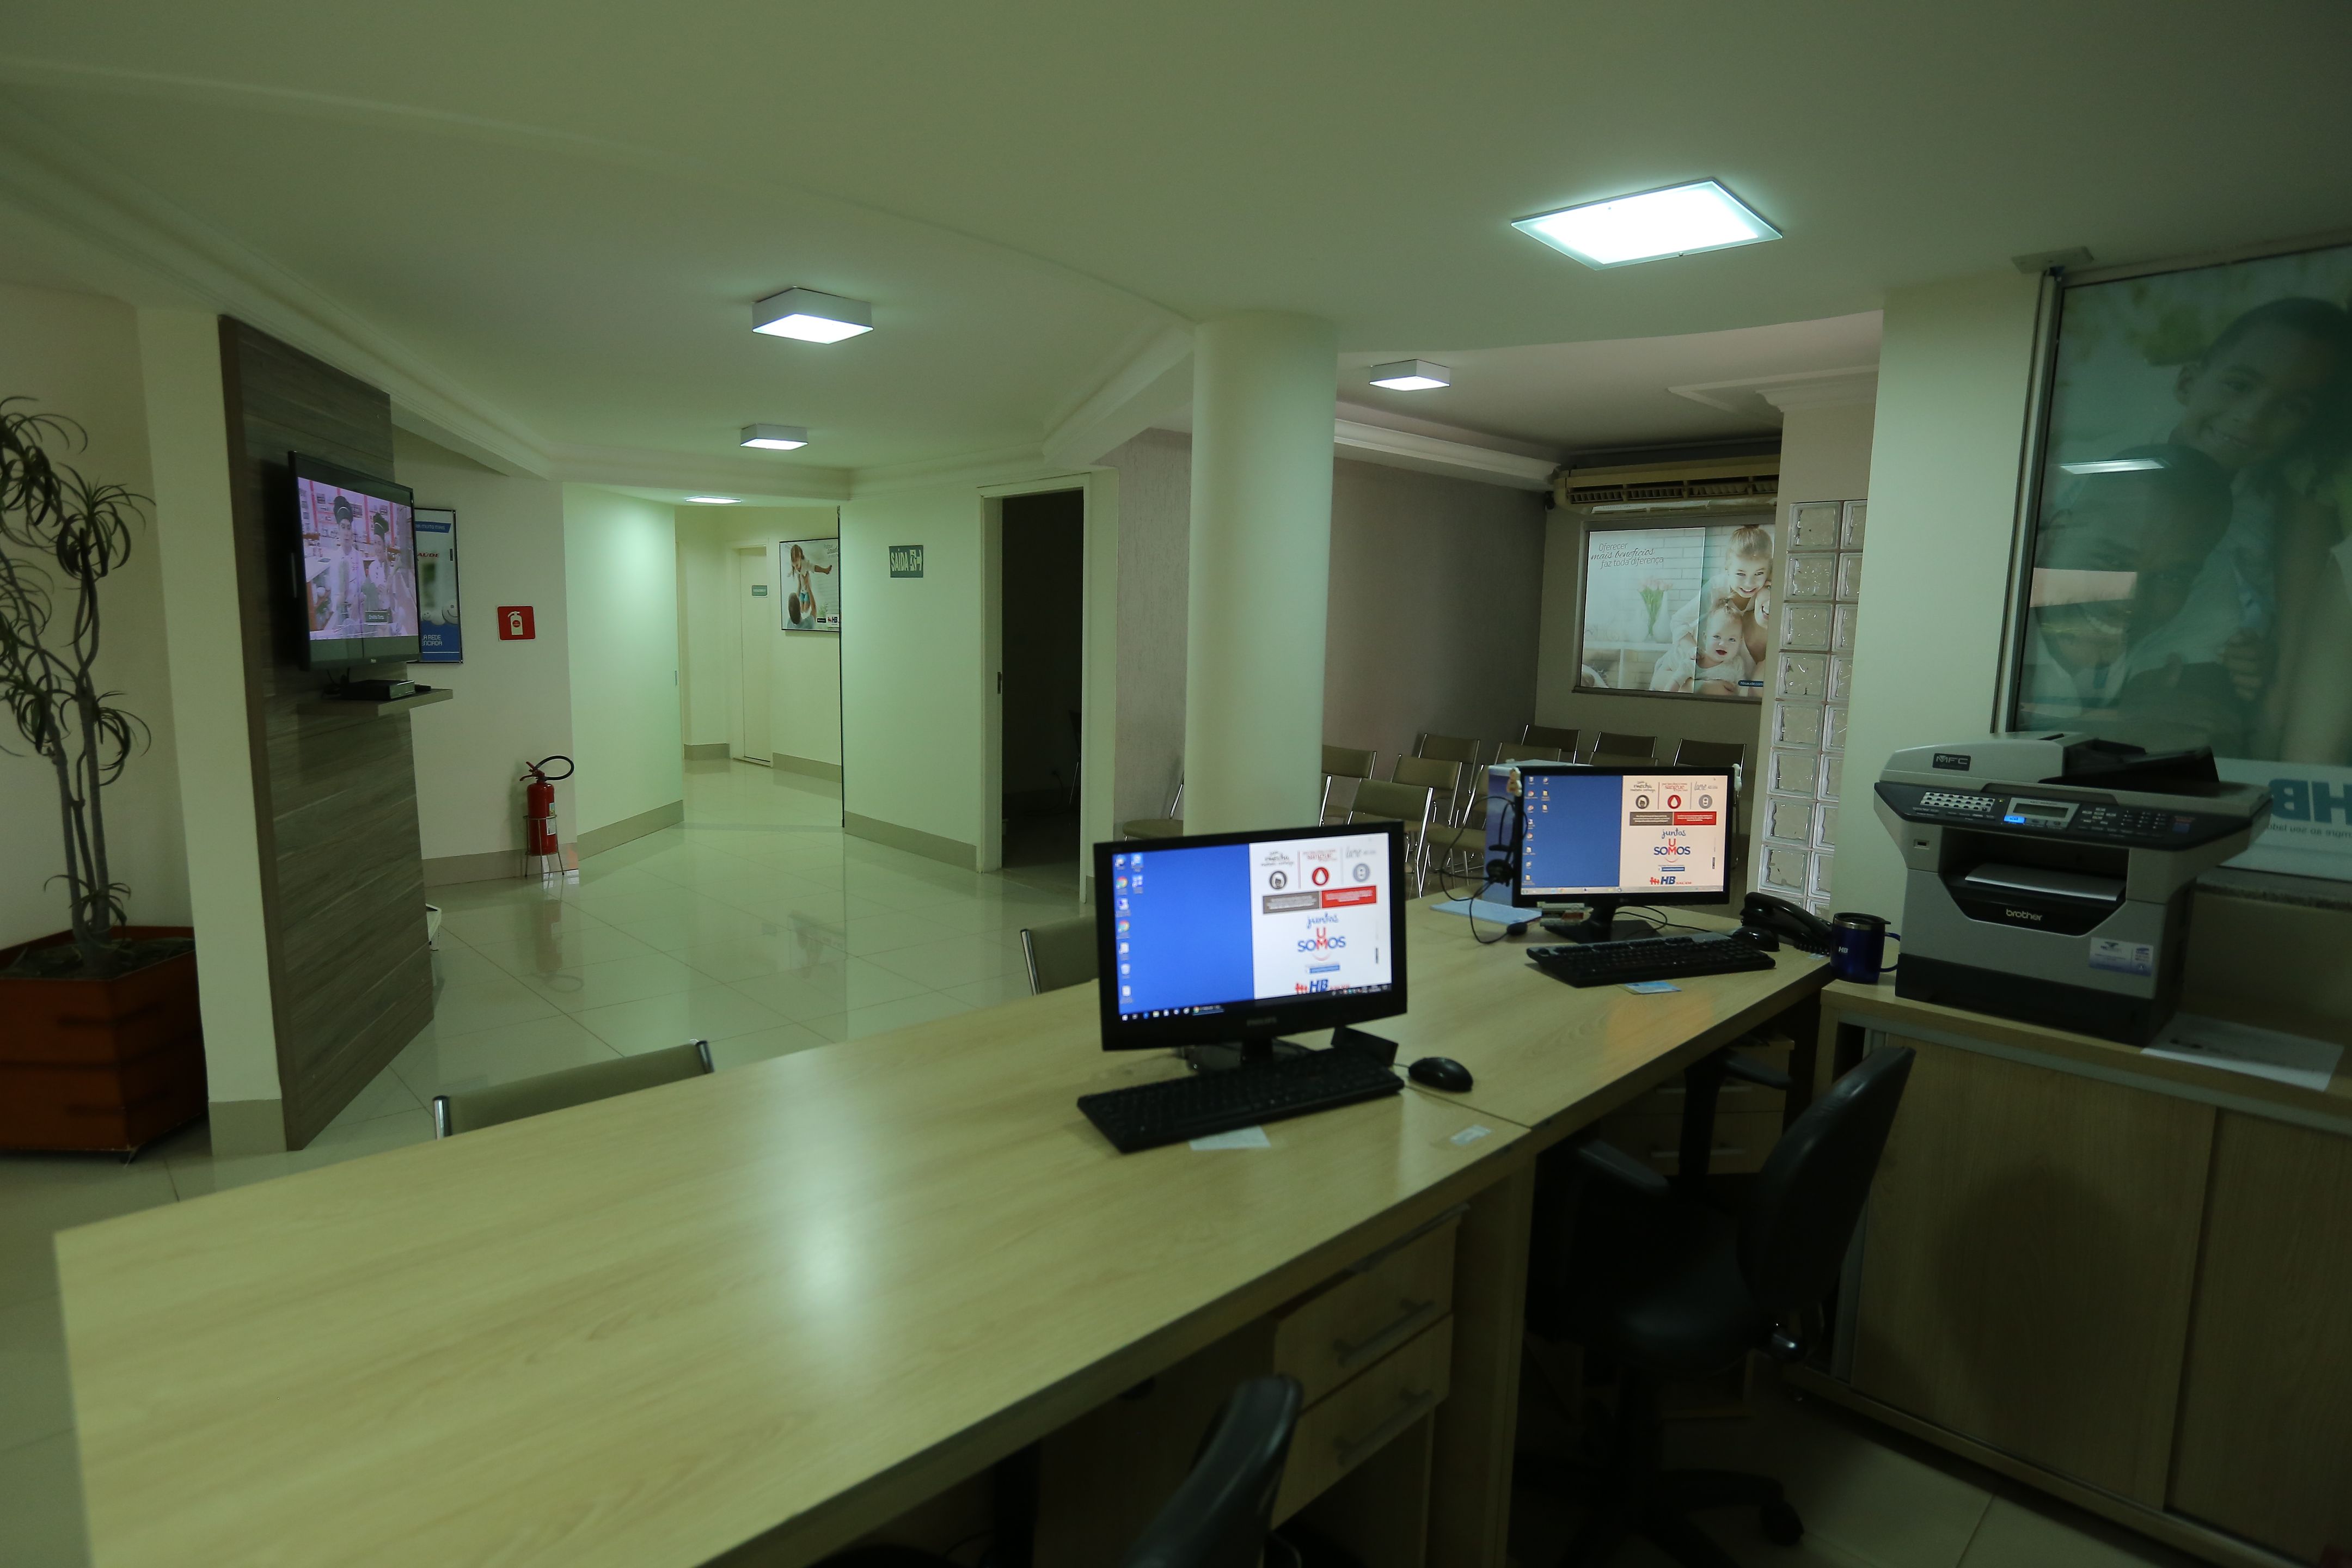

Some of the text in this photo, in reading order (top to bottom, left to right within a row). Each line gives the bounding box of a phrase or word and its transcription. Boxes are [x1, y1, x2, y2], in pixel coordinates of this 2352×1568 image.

[1598, 543, 1628, 553] Oferecer
[891, 548, 909, 572] SAÍDA
[1600, 556, 1664, 569] faz toda diferença
[1936, 755, 1968, 765] MFC
[1653, 846, 1690, 855] SOMOS
[1661, 876, 1676, 885] HB
[2006, 909, 2043, 921] brother
[1298, 936, 1346, 952] SOMOS
